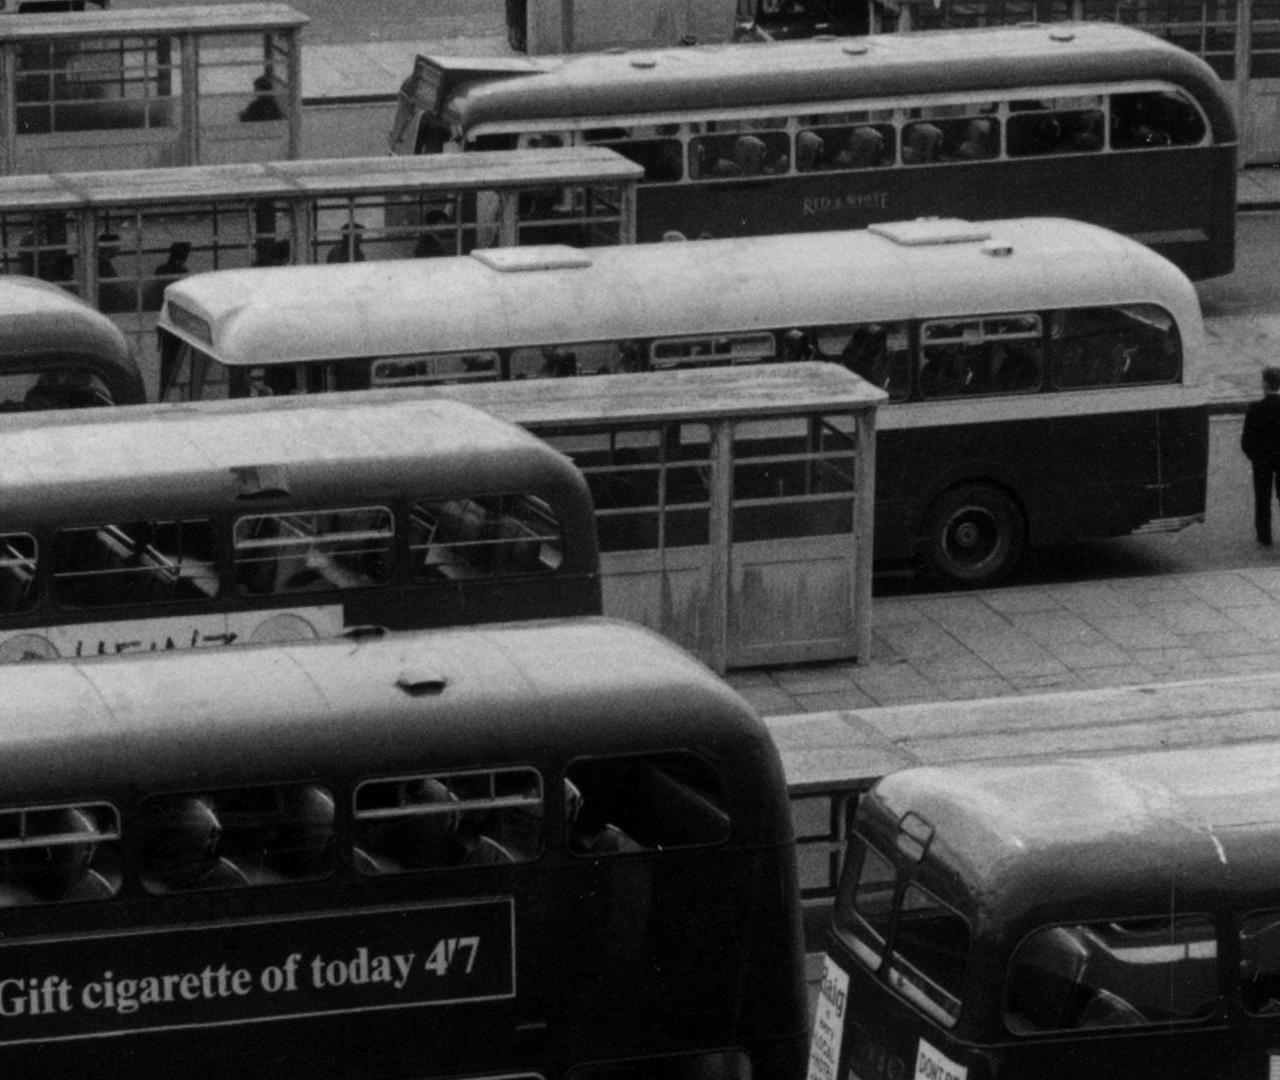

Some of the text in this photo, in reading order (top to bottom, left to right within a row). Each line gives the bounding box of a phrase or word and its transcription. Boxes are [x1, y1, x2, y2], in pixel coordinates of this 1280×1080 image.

[802, 197, 831, 216] RED
[81, 964, 254, 1014] cigarette
[260, 953, 303, 993] of
[310, 947, 417, 990] today
